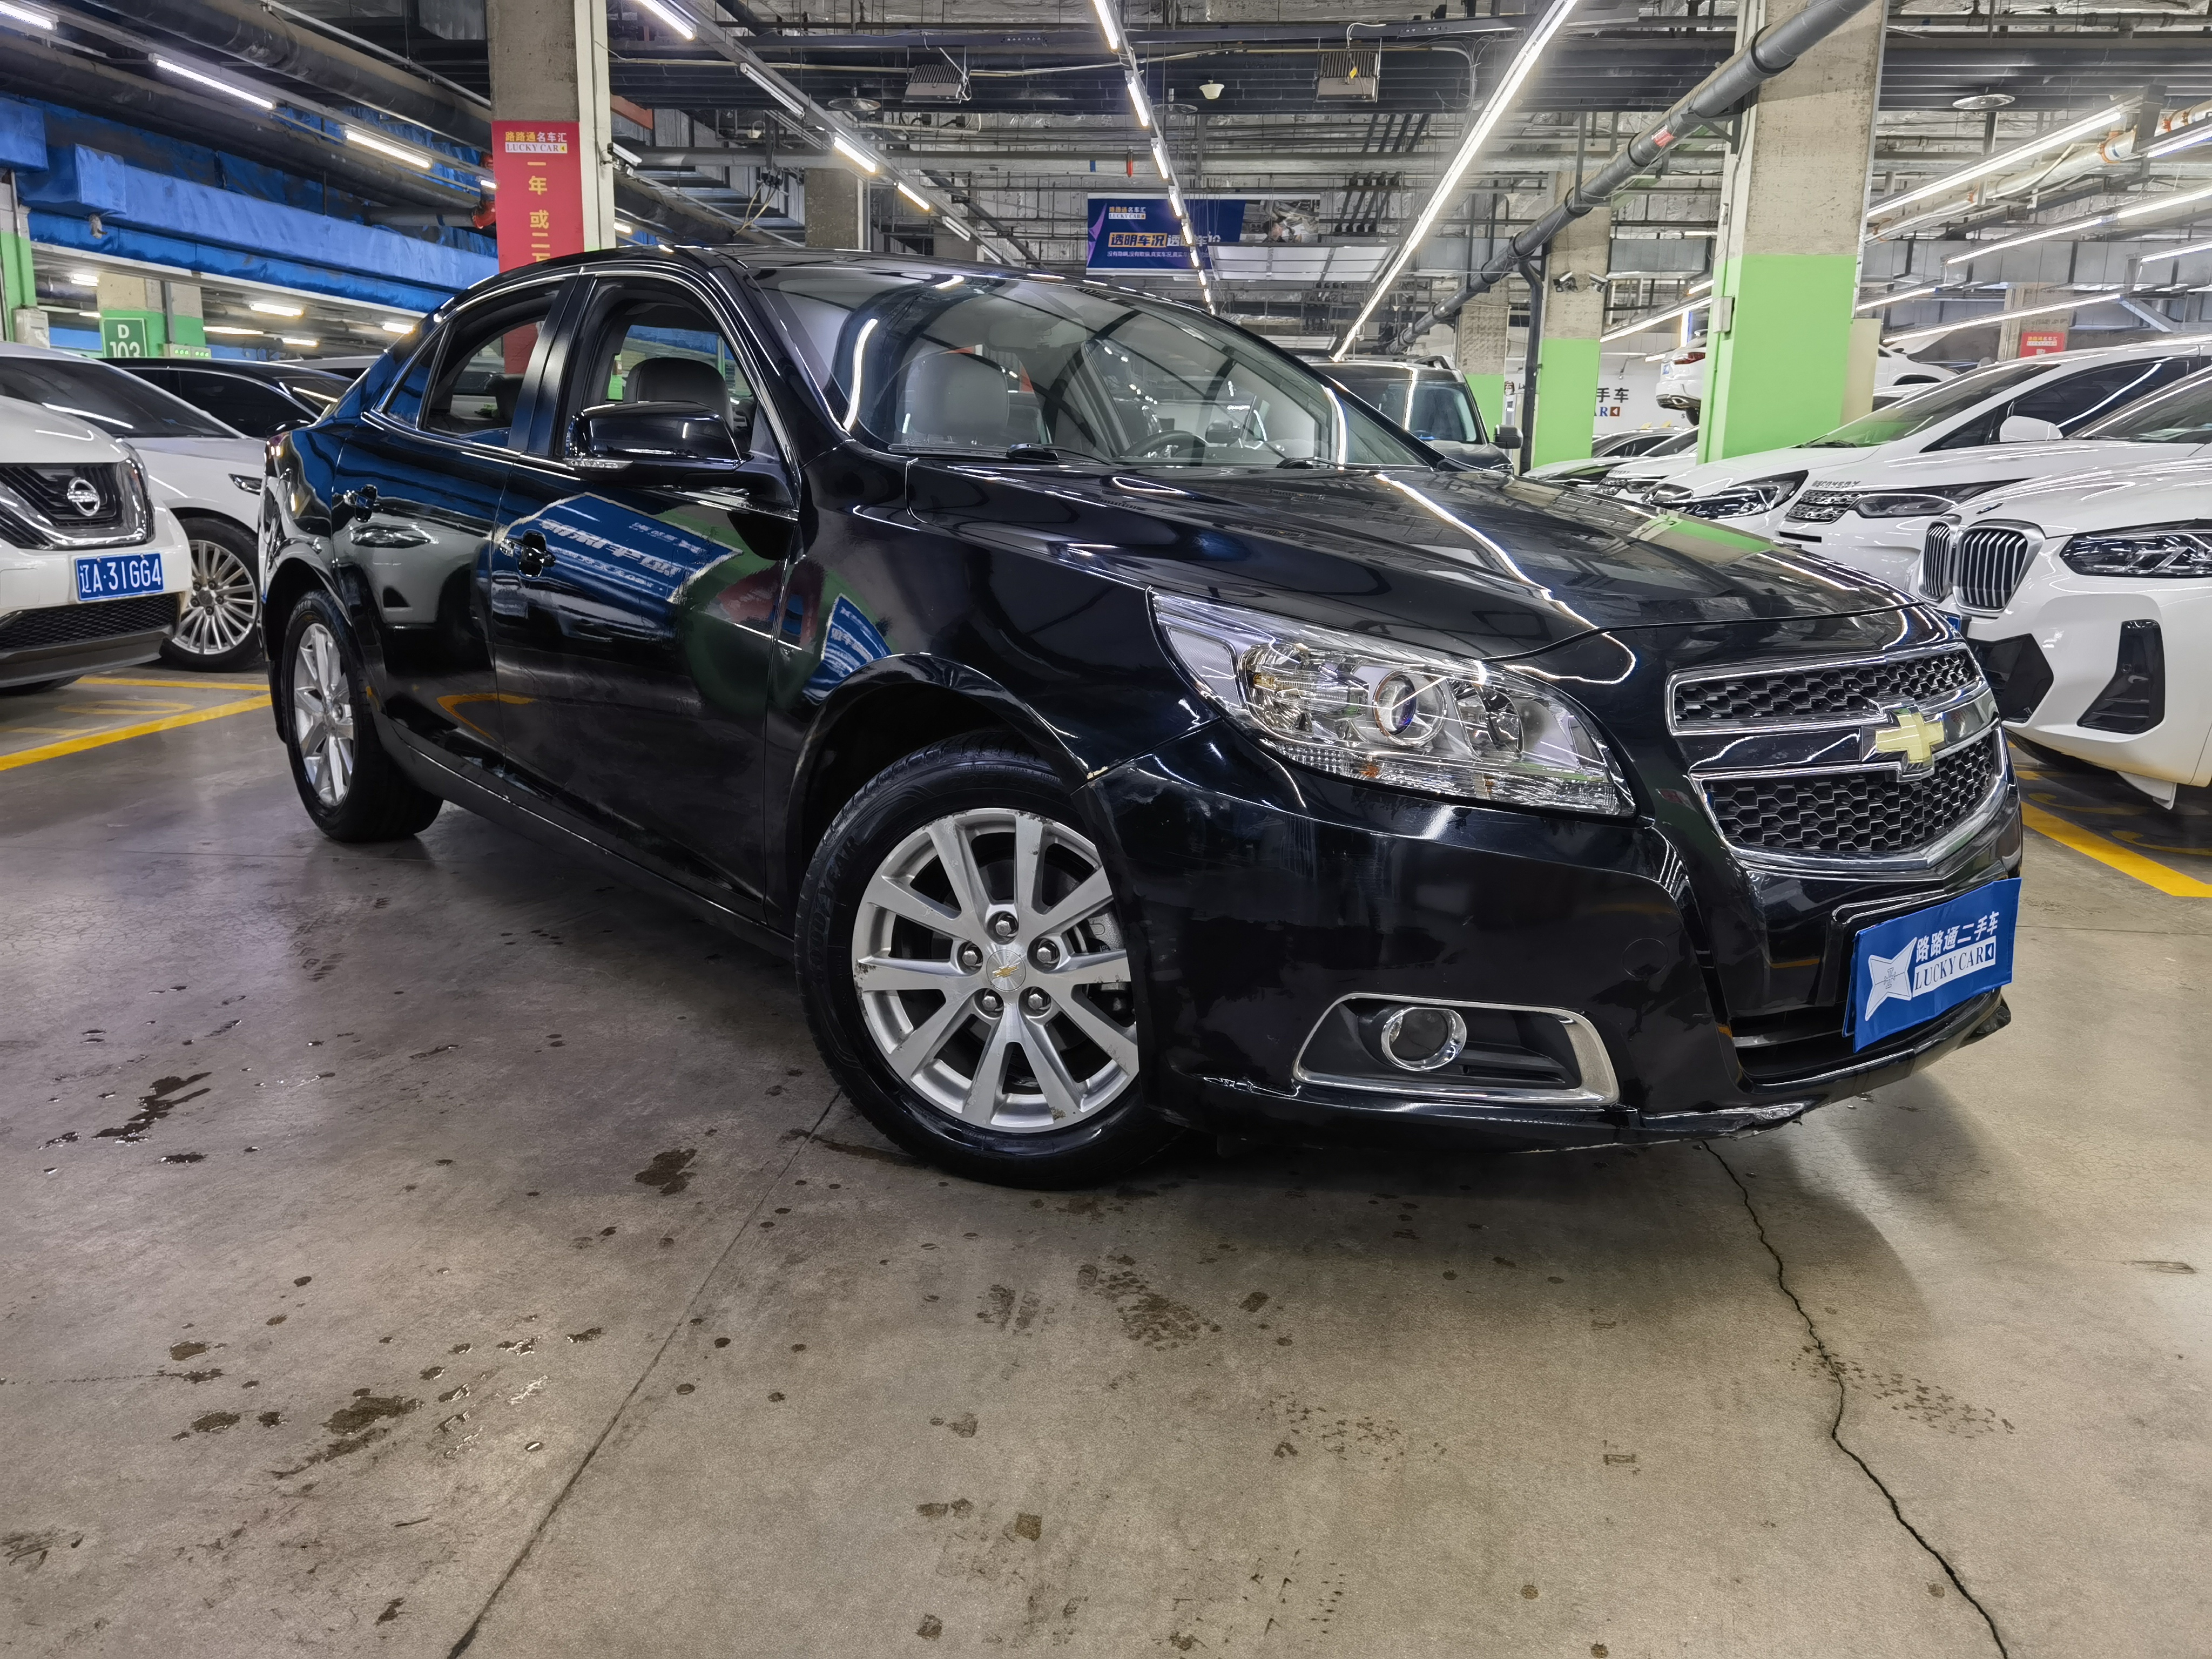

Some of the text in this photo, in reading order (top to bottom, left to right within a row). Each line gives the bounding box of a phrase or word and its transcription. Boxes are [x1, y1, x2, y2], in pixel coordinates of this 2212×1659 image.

[505, 131, 567, 142] 路路通名车汇
[1111, 234, 1165, 246] 透明车况
[117, 325, 130, 339] D
[110, 341, 140, 358] 103
[1916, 911, 1999, 963] 路路通二手车
[1914, 946, 1984, 991] LUCKY CAR
